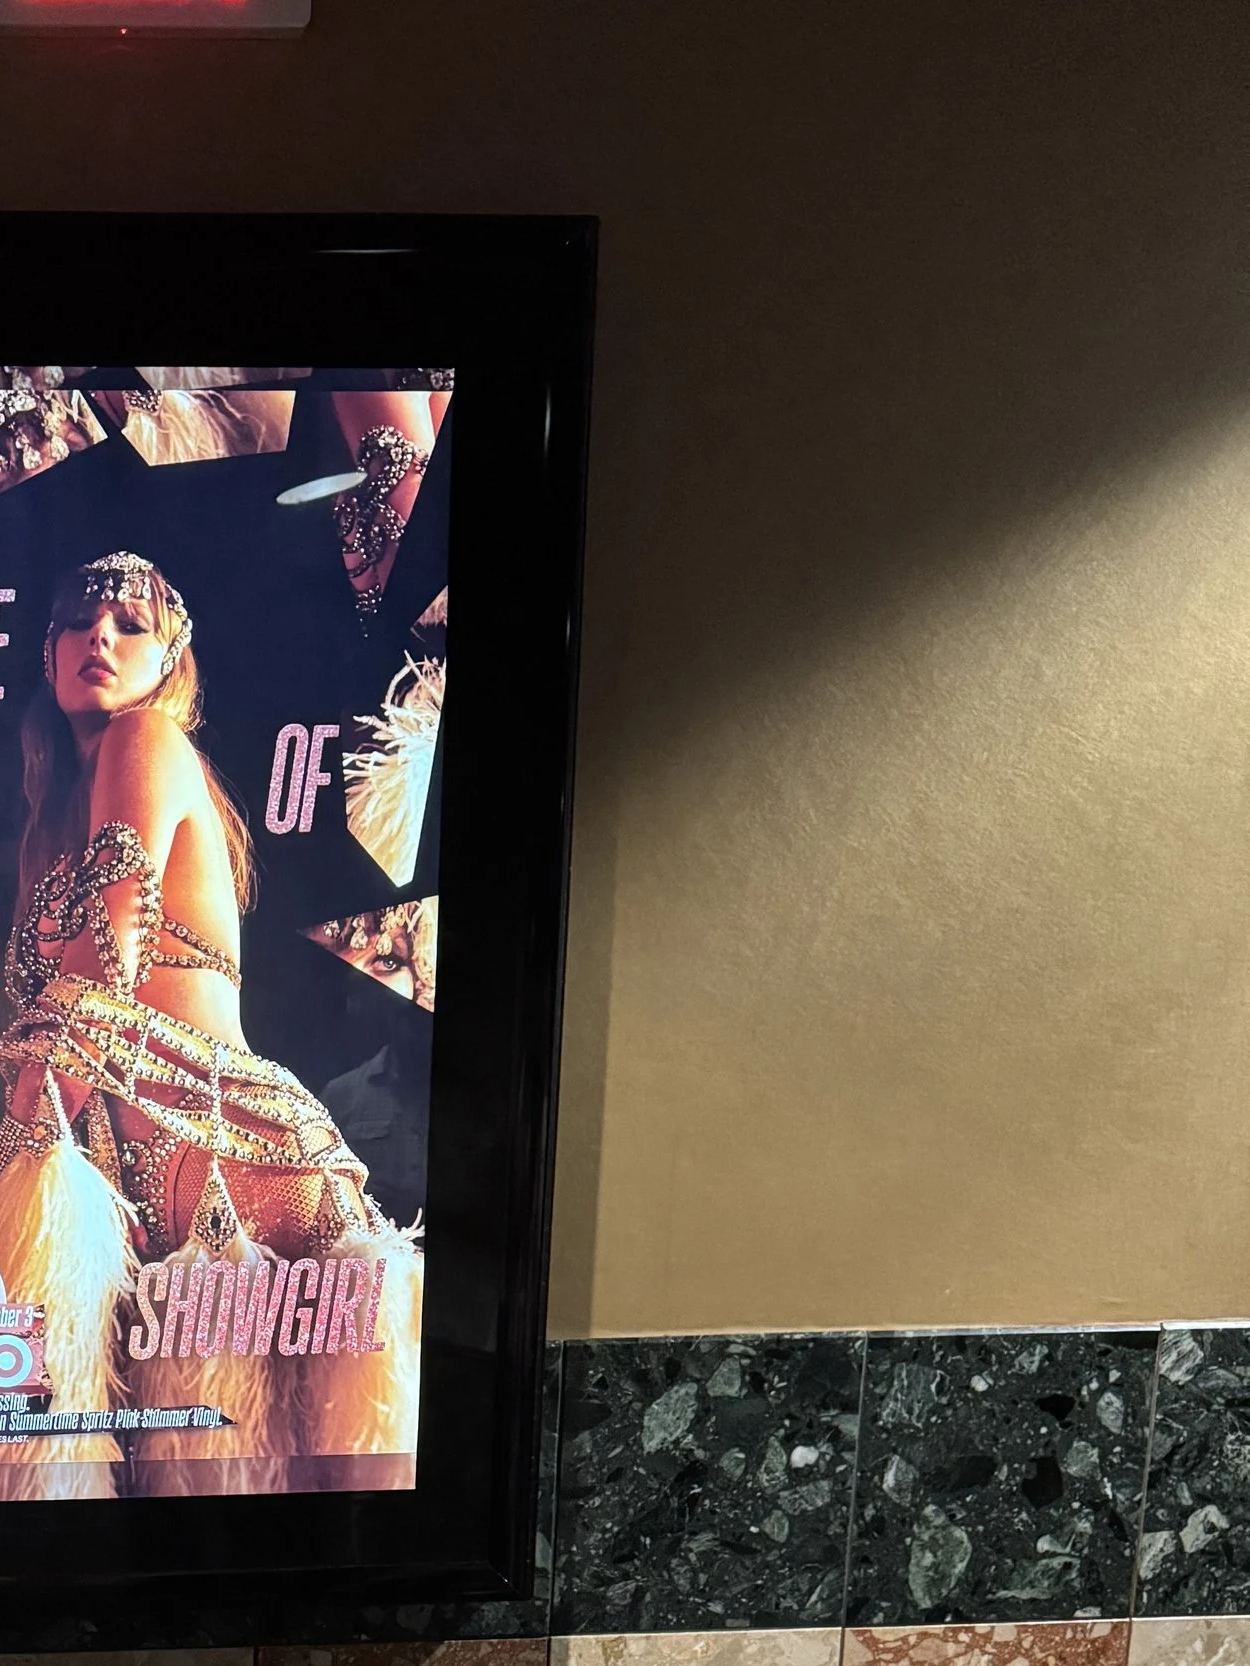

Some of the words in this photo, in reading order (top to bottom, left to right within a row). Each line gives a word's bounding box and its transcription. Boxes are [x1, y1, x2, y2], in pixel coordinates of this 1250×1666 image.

[265, 723, 340, 834] OF
[24, 1305, 34, 1327] 3
[129, 1257, 387, 1360] SHOWGIRL
[9, 1410, 79, 1431] Summertime
[81, 1409, 115, 1432] Spritz
